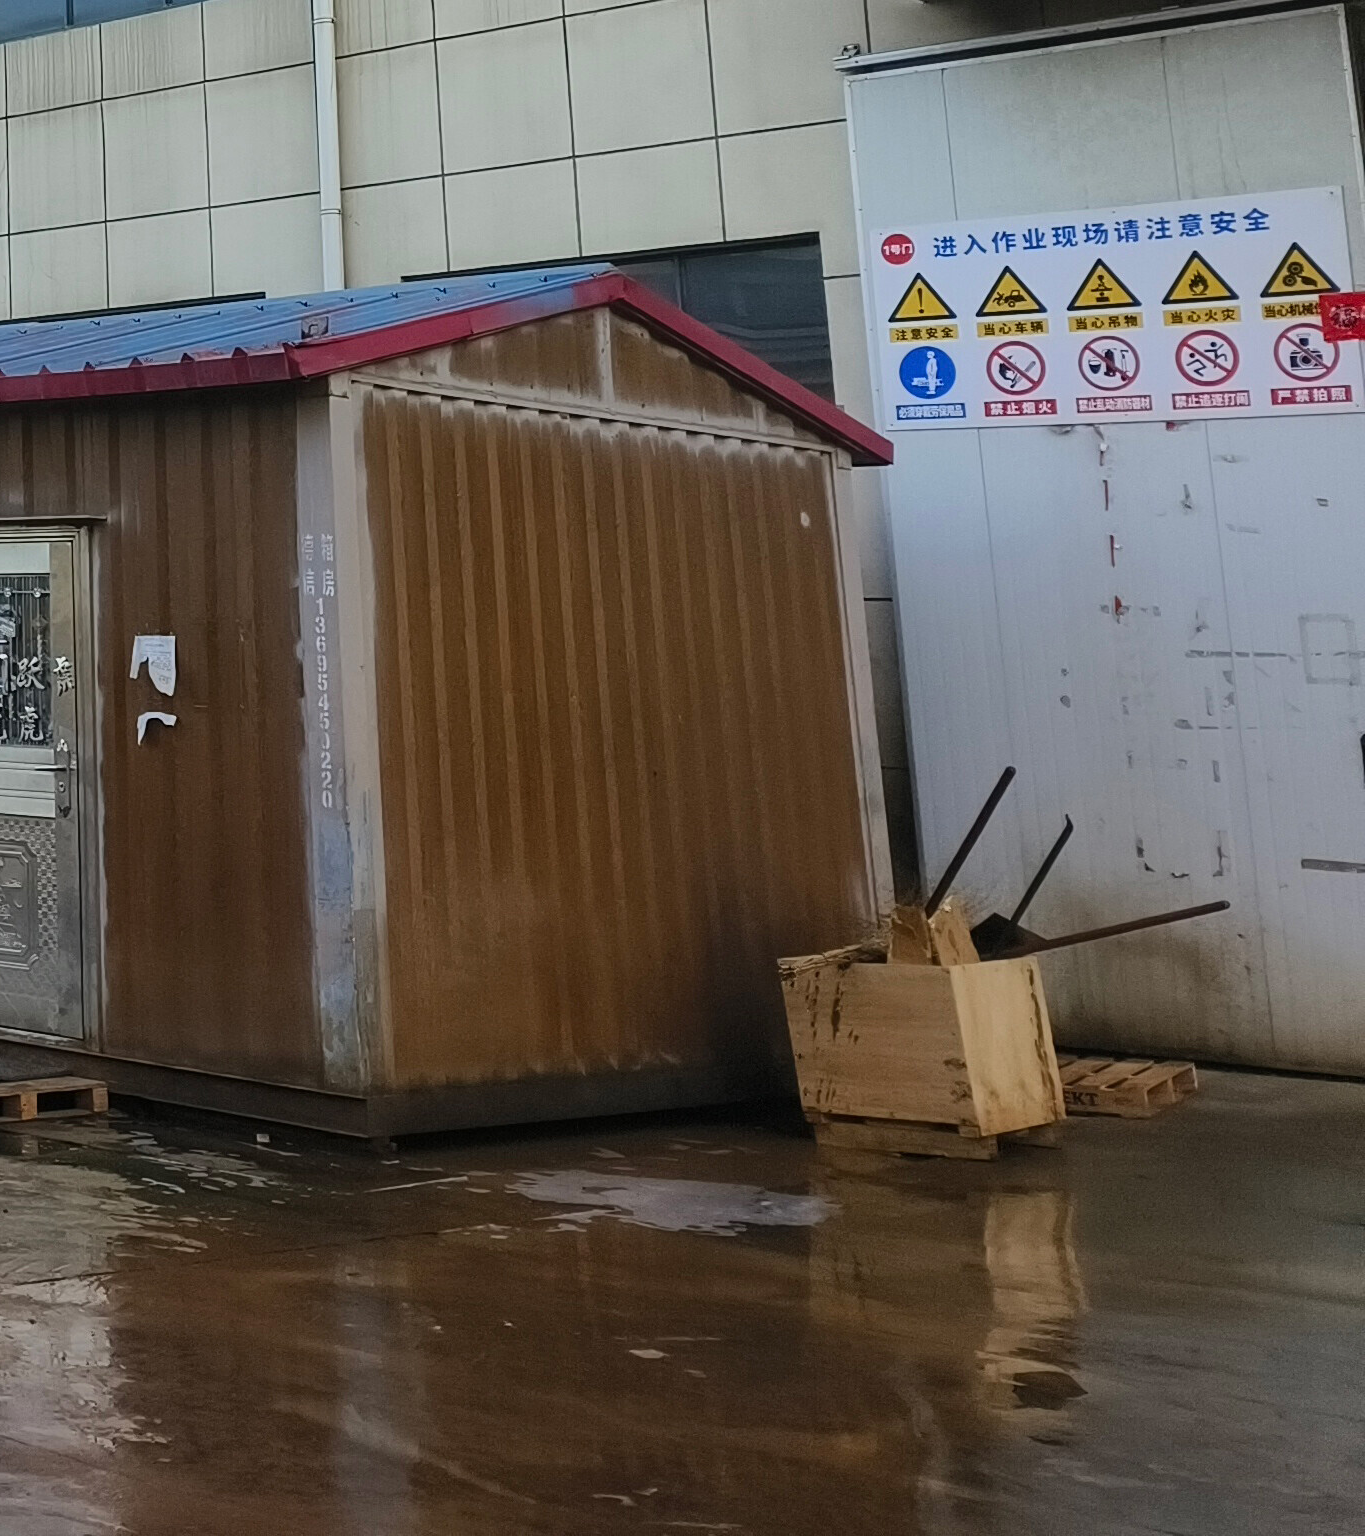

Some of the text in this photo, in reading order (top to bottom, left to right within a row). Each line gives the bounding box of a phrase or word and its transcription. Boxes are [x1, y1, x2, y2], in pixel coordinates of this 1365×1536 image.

[933, 208, 1270, 258] 进入作业现场请注意安全
[883, 242, 913, 256] 1号门
[1075, 315, 1138, 331] 当心吊物
[1170, 309, 1236, 324] 当心火灾
[895, 327, 954, 341] 注意安全
[984, 321, 1044, 335] 当心车辆
[1277, 387, 1347, 403] 严禁拍照
[990, 401, 1053, 415] 禁止烟火
